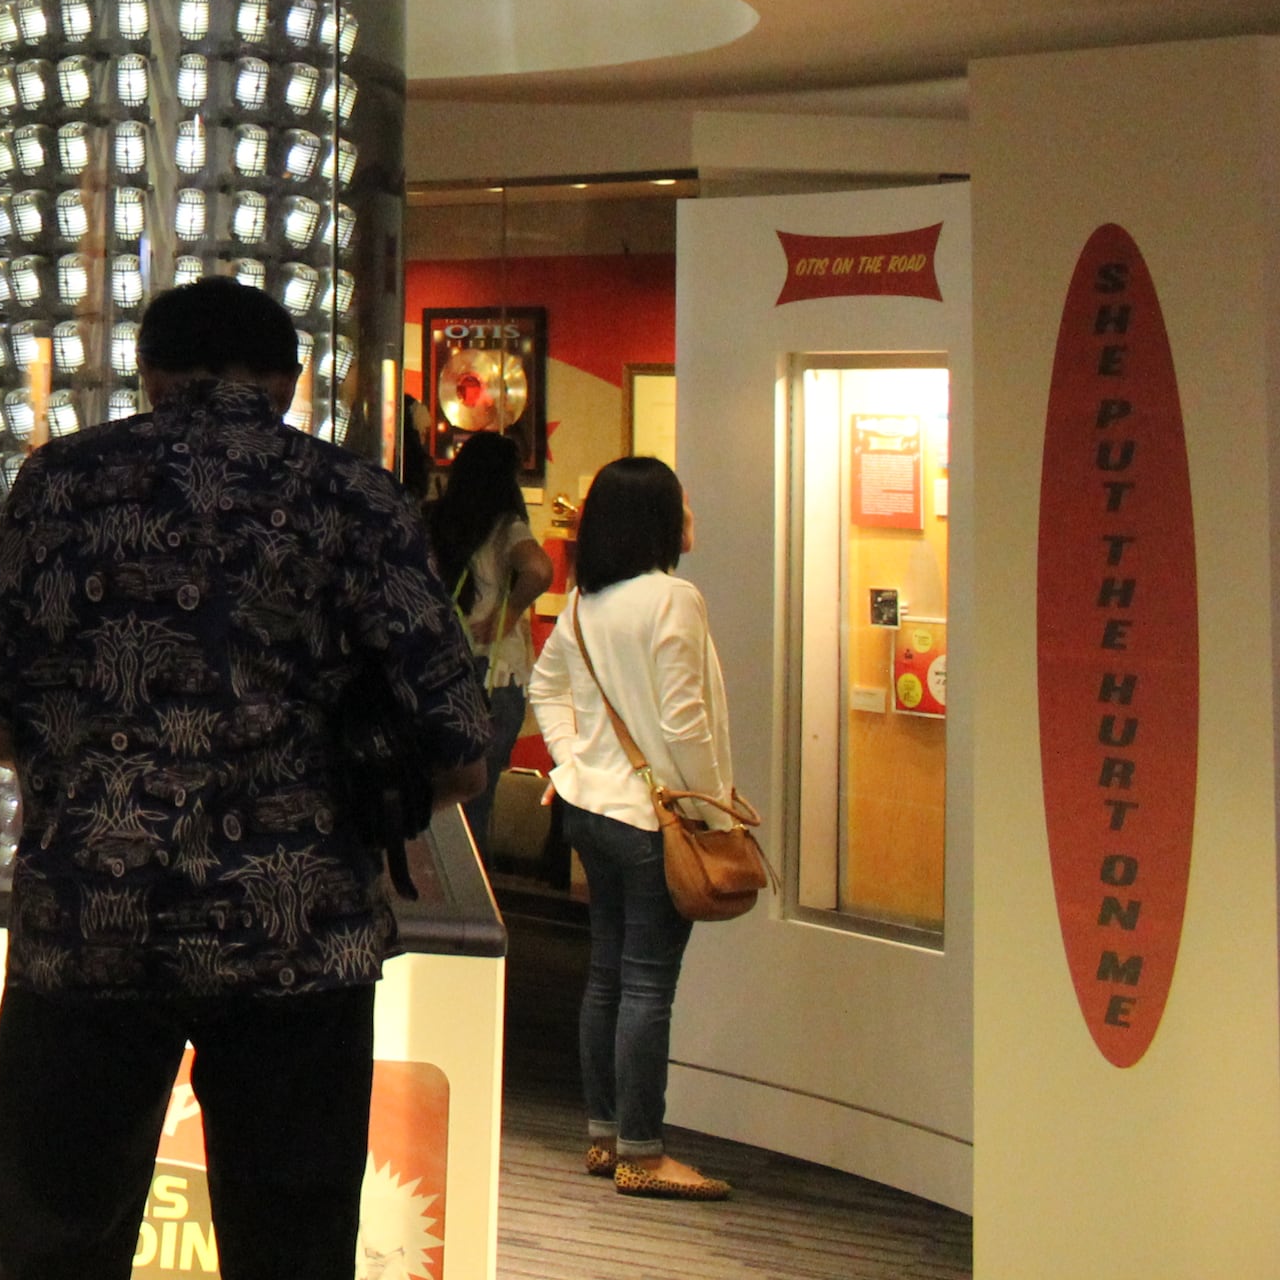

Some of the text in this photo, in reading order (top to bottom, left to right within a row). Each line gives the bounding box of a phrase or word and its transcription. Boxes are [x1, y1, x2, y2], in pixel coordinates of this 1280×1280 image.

[796, 254, 927, 276] OTIS ON THE ROAD
[444, 323, 521, 339] OTIS
[1094, 263, 1144, 1029] SHE PUT THE HURT ON ME
